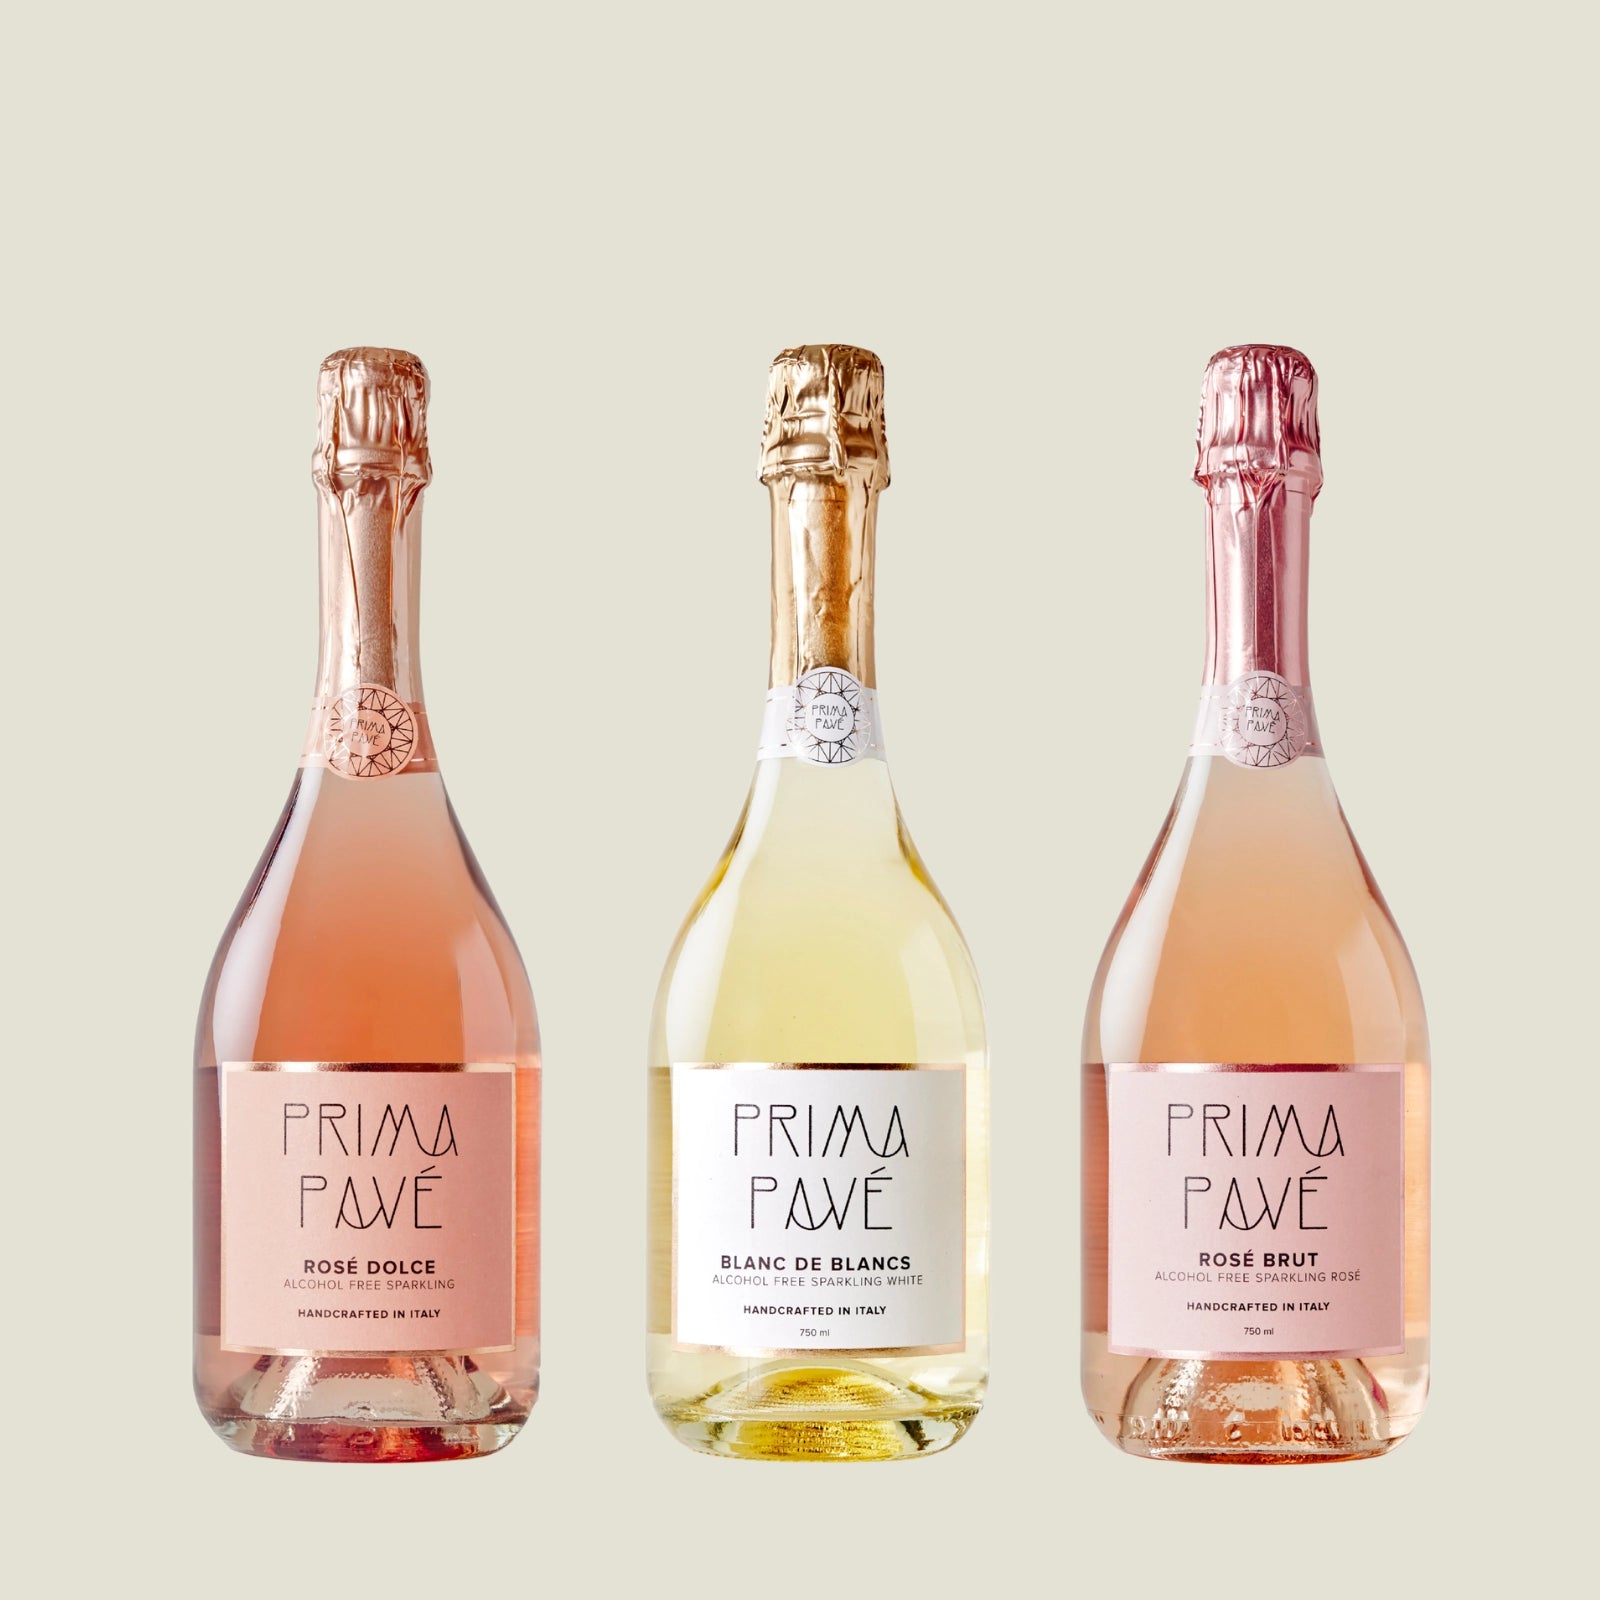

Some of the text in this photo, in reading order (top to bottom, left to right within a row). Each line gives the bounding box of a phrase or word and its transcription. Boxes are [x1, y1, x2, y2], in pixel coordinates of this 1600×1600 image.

[812, 705, 848, 717] PRIMA
[1245, 706, 1280, 721] PRIMA
[284, 1103, 458, 1157] PRIMA
[734, 1104, 909, 1158] PRIMA
[1167, 1104, 1345, 1157] PRIMA
[300, 1166, 443, 1229] PAVÉ
[750, 1167, 893, 1230] PAVÉ
[1184, 1166, 1328, 1230] PAVÉ
[304, 1257, 436, 1275] ROSÉ DOLCE
[721, 1256, 911, 1271] BLANC DE BLANCS
[1199, 1250, 1319, 1268] ROSÉ BRUT
[712, 1275, 923, 1287] ALCOHOL FREE SPARKLING WHITE
[1155, 1269, 1361, 1283] ALCOHOL FREE SPARKLING ROSÉ
[283, 1279, 455, 1290] ALCOHOL FREE SPARKLING
[298, 1309, 441, 1319] HANDCRAFTED IN ITALY
[743, 1305, 887, 1316] HANDCRAFTED IN ITALY
[1187, 1302, 1330, 1312] HANDCRAFTED IN ITALY
[800, 1328, 830, 1337] 750 ml
[1244, 1327, 1274, 1336] 750 ml
